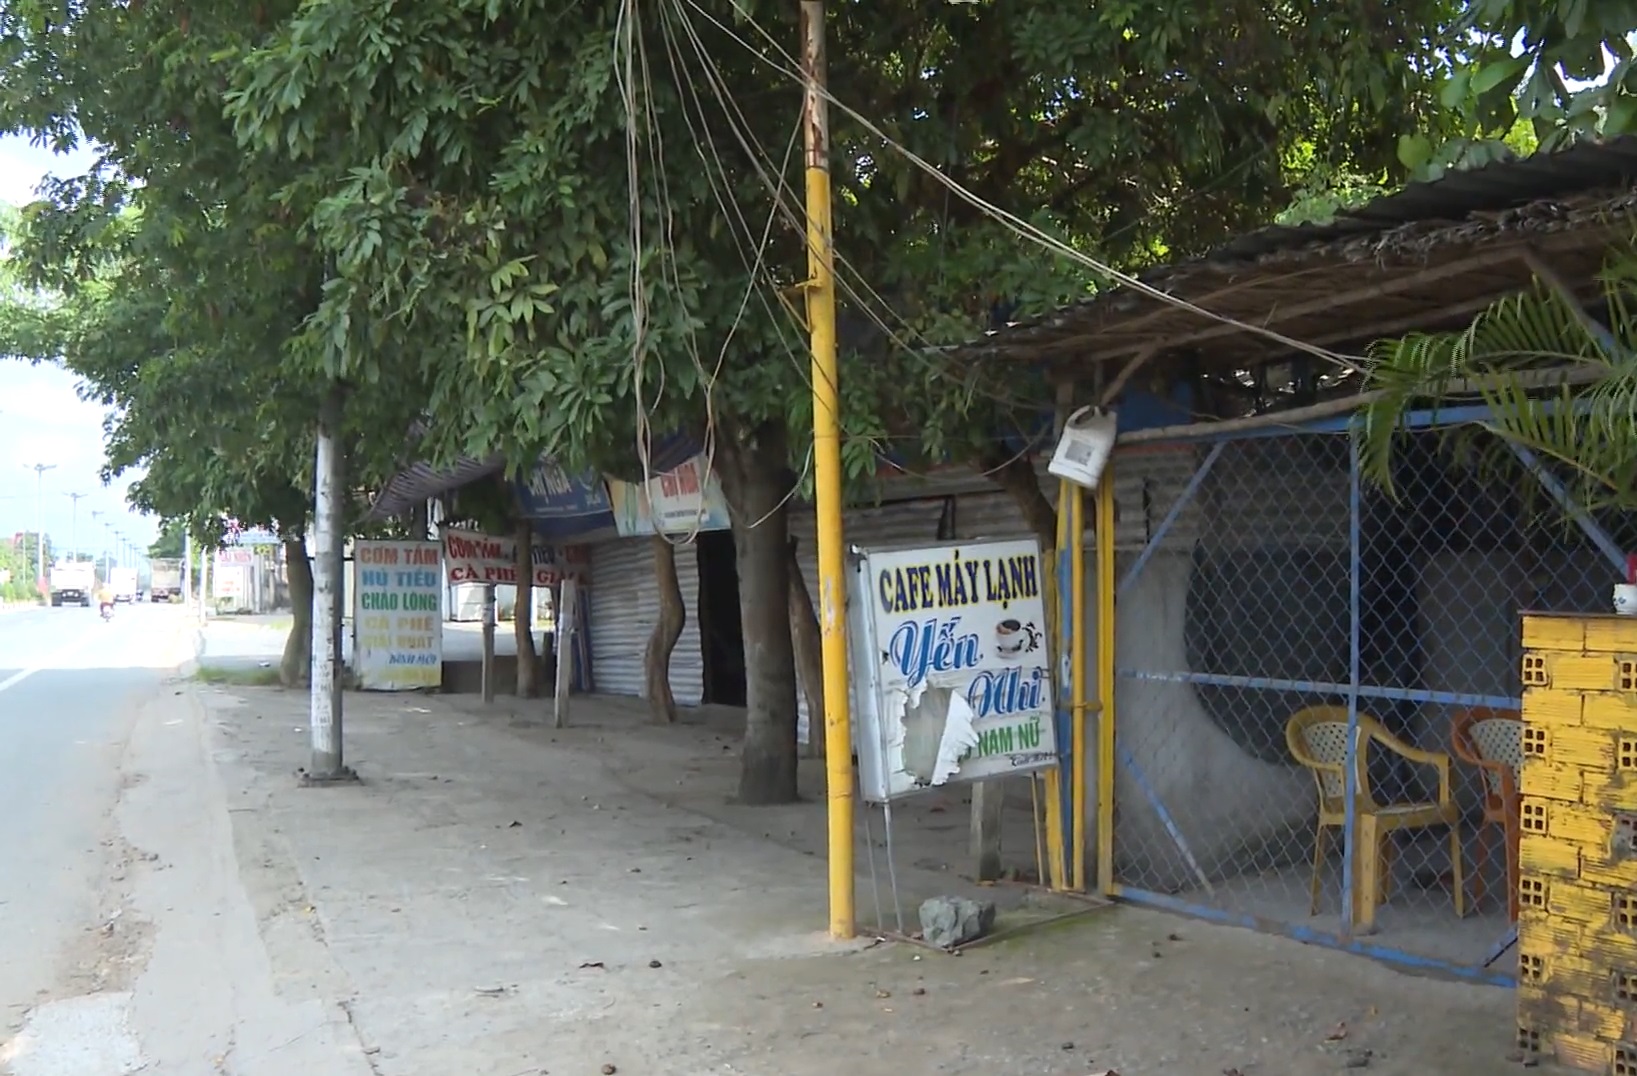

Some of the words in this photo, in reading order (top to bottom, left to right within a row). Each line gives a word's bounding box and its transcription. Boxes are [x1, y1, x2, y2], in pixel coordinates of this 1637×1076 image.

[360, 545, 399, 566] CƠM
[450, 563, 480, 581] CÀ
[879, 564, 934, 615] CAFE
[935, 549, 980, 607] MÁY
[983, 554, 1039, 610] LẠNH
[977, 725, 1013, 758] NAM
[1018, 715, 1041, 750] NỮ
